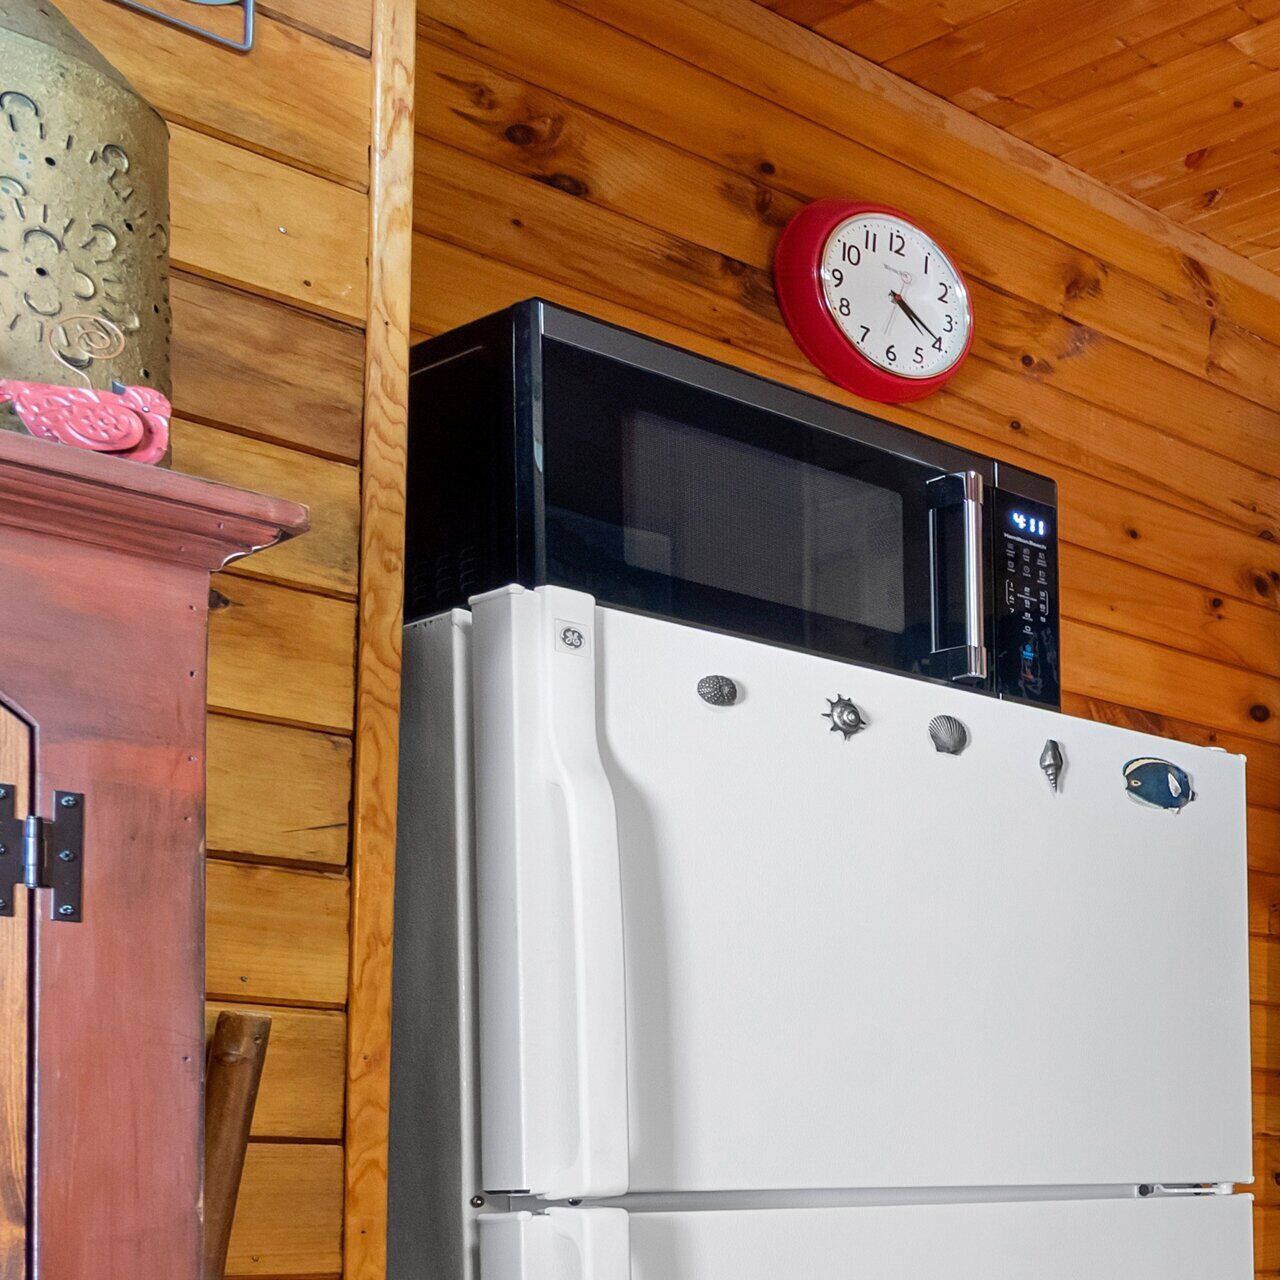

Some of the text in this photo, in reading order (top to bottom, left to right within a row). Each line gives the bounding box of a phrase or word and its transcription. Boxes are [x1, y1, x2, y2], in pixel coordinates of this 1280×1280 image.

[865, 230, 877, 252] 11
[889, 232, 906, 257] 12
[842, 242, 861, 266] 10
[924, 255, 929, 275] 1
[831, 268, 844, 287] 9
[937, 282, 949, 304] 2
[838, 297, 851, 316] 8
[942, 314, 953, 333] 3
[859, 325, 870, 343] 7
[885, 344, 897, 362] 6
[931, 336, 943, 352] 4
[912, 346, 924, 364] 5
